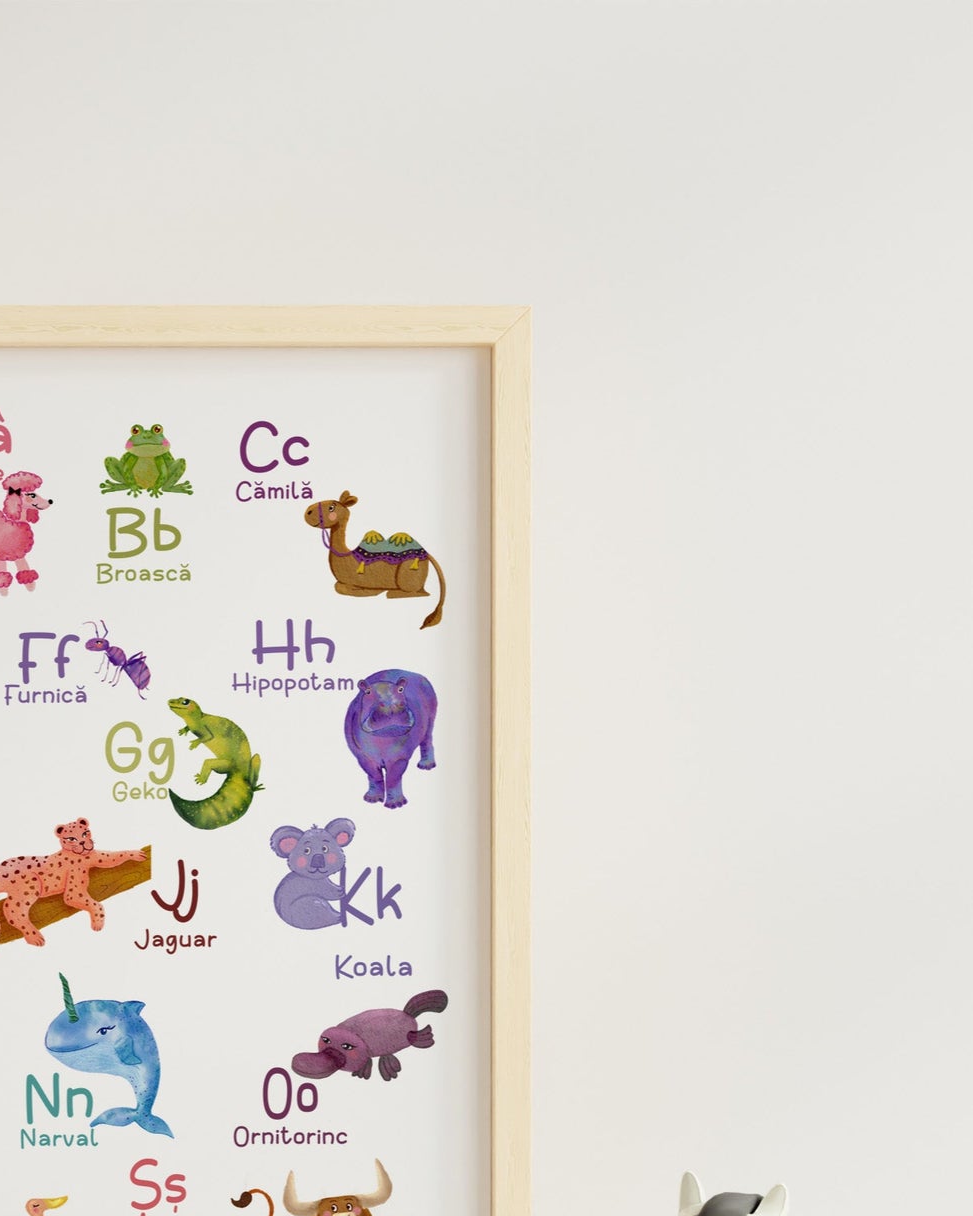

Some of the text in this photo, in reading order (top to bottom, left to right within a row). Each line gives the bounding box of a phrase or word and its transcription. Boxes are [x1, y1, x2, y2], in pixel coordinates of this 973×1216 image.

[239, 421, 310, 474] Cc
[236, 480, 314, 502] Cămilă
[106, 507, 182, 559] Bb
[96, 563, 192, 584] Broască
[18, 632, 80, 685] Ff
[252, 619, 336, 671] Hh
[4, 684, 88, 705] Furnică
[232, 672, 354, 697] Hipopotam
[105, 721, 175, 785] Gg
[112, 781, 168, 802] Geko
[151, 859, 199, 923] Jj
[340, 866, 402, 927] Kk
[135, 929, 217, 954] Jaguar
[335, 955, 412, 980] Koala
[26, 1072, 93, 1124] Nn
[263, 1067, 318, 1120] Oo
[20, 1129, 98, 1149] Narval
[233, 1126, 348, 1148] Ornitorinc
